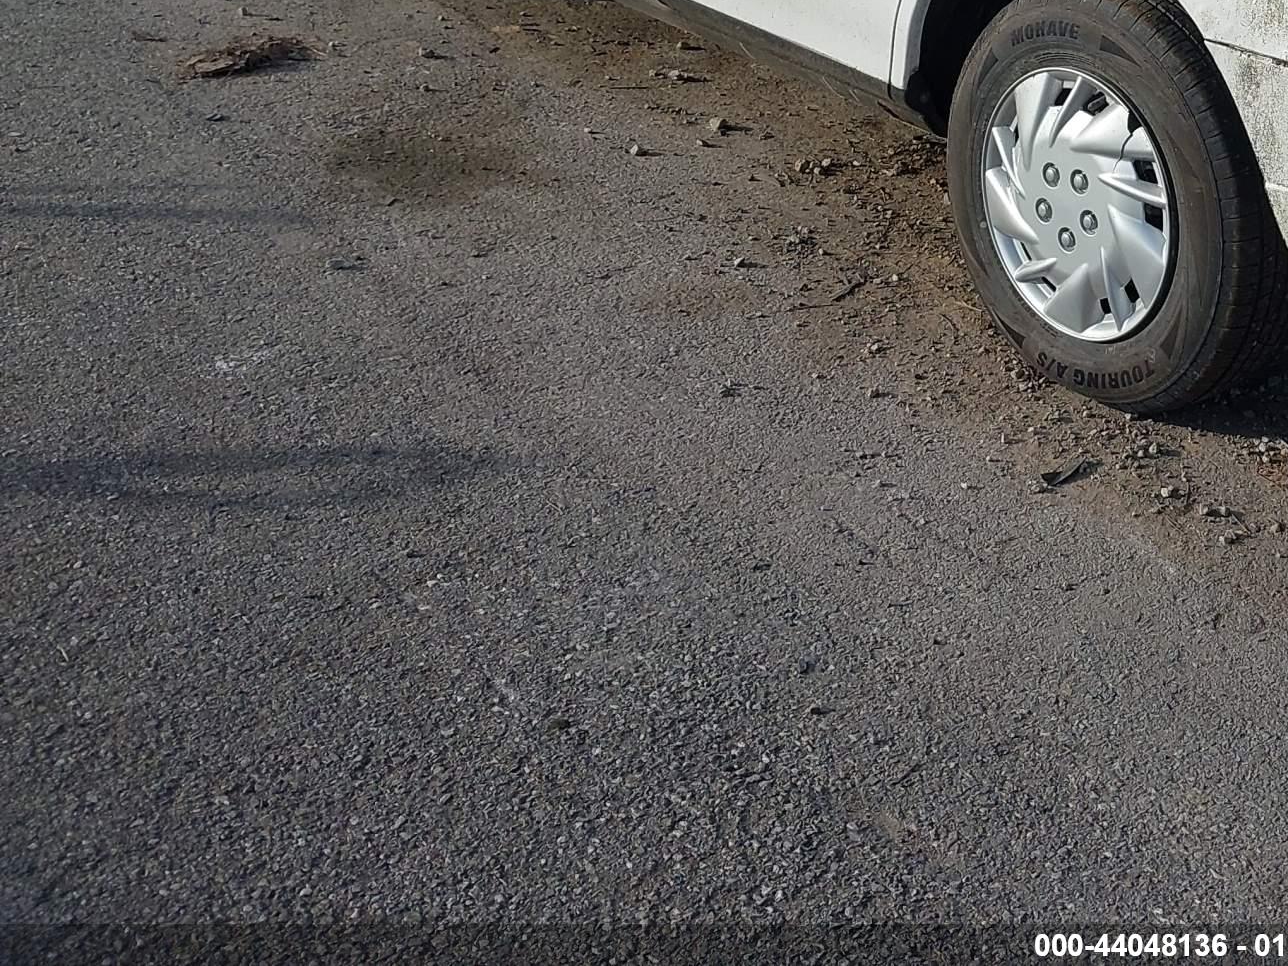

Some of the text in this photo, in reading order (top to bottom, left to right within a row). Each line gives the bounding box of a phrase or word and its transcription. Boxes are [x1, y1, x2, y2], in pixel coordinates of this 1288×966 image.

[1009, 20, 1081, 47] MOHAVE
[1036, 351, 1155, 389] TOURING A/S
